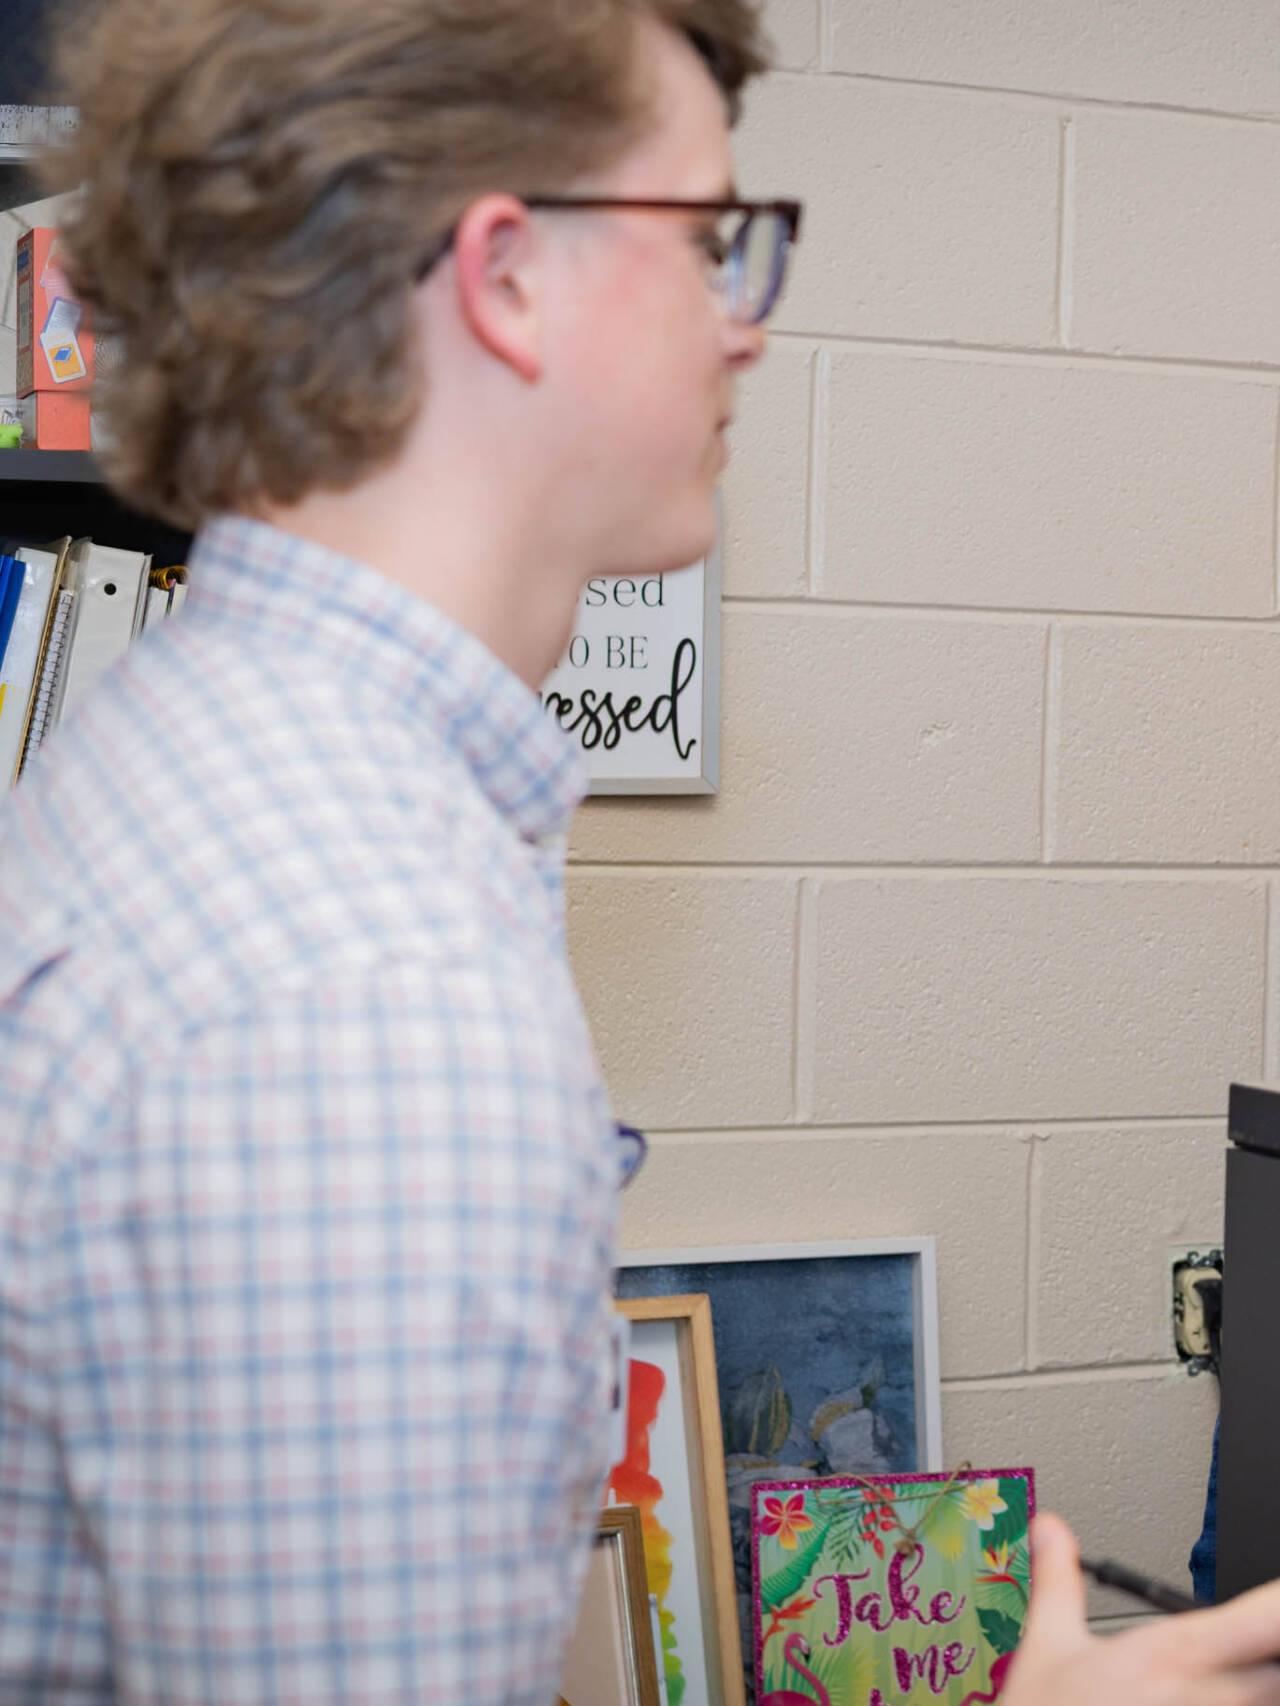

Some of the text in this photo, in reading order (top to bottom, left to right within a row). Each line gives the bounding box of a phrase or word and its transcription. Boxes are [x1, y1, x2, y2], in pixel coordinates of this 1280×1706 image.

[585, 573, 665, 608] sed
[567, 634, 649, 669] O BE
[812, 1543, 967, 1647] Take
[892, 1641, 976, 1695] me
